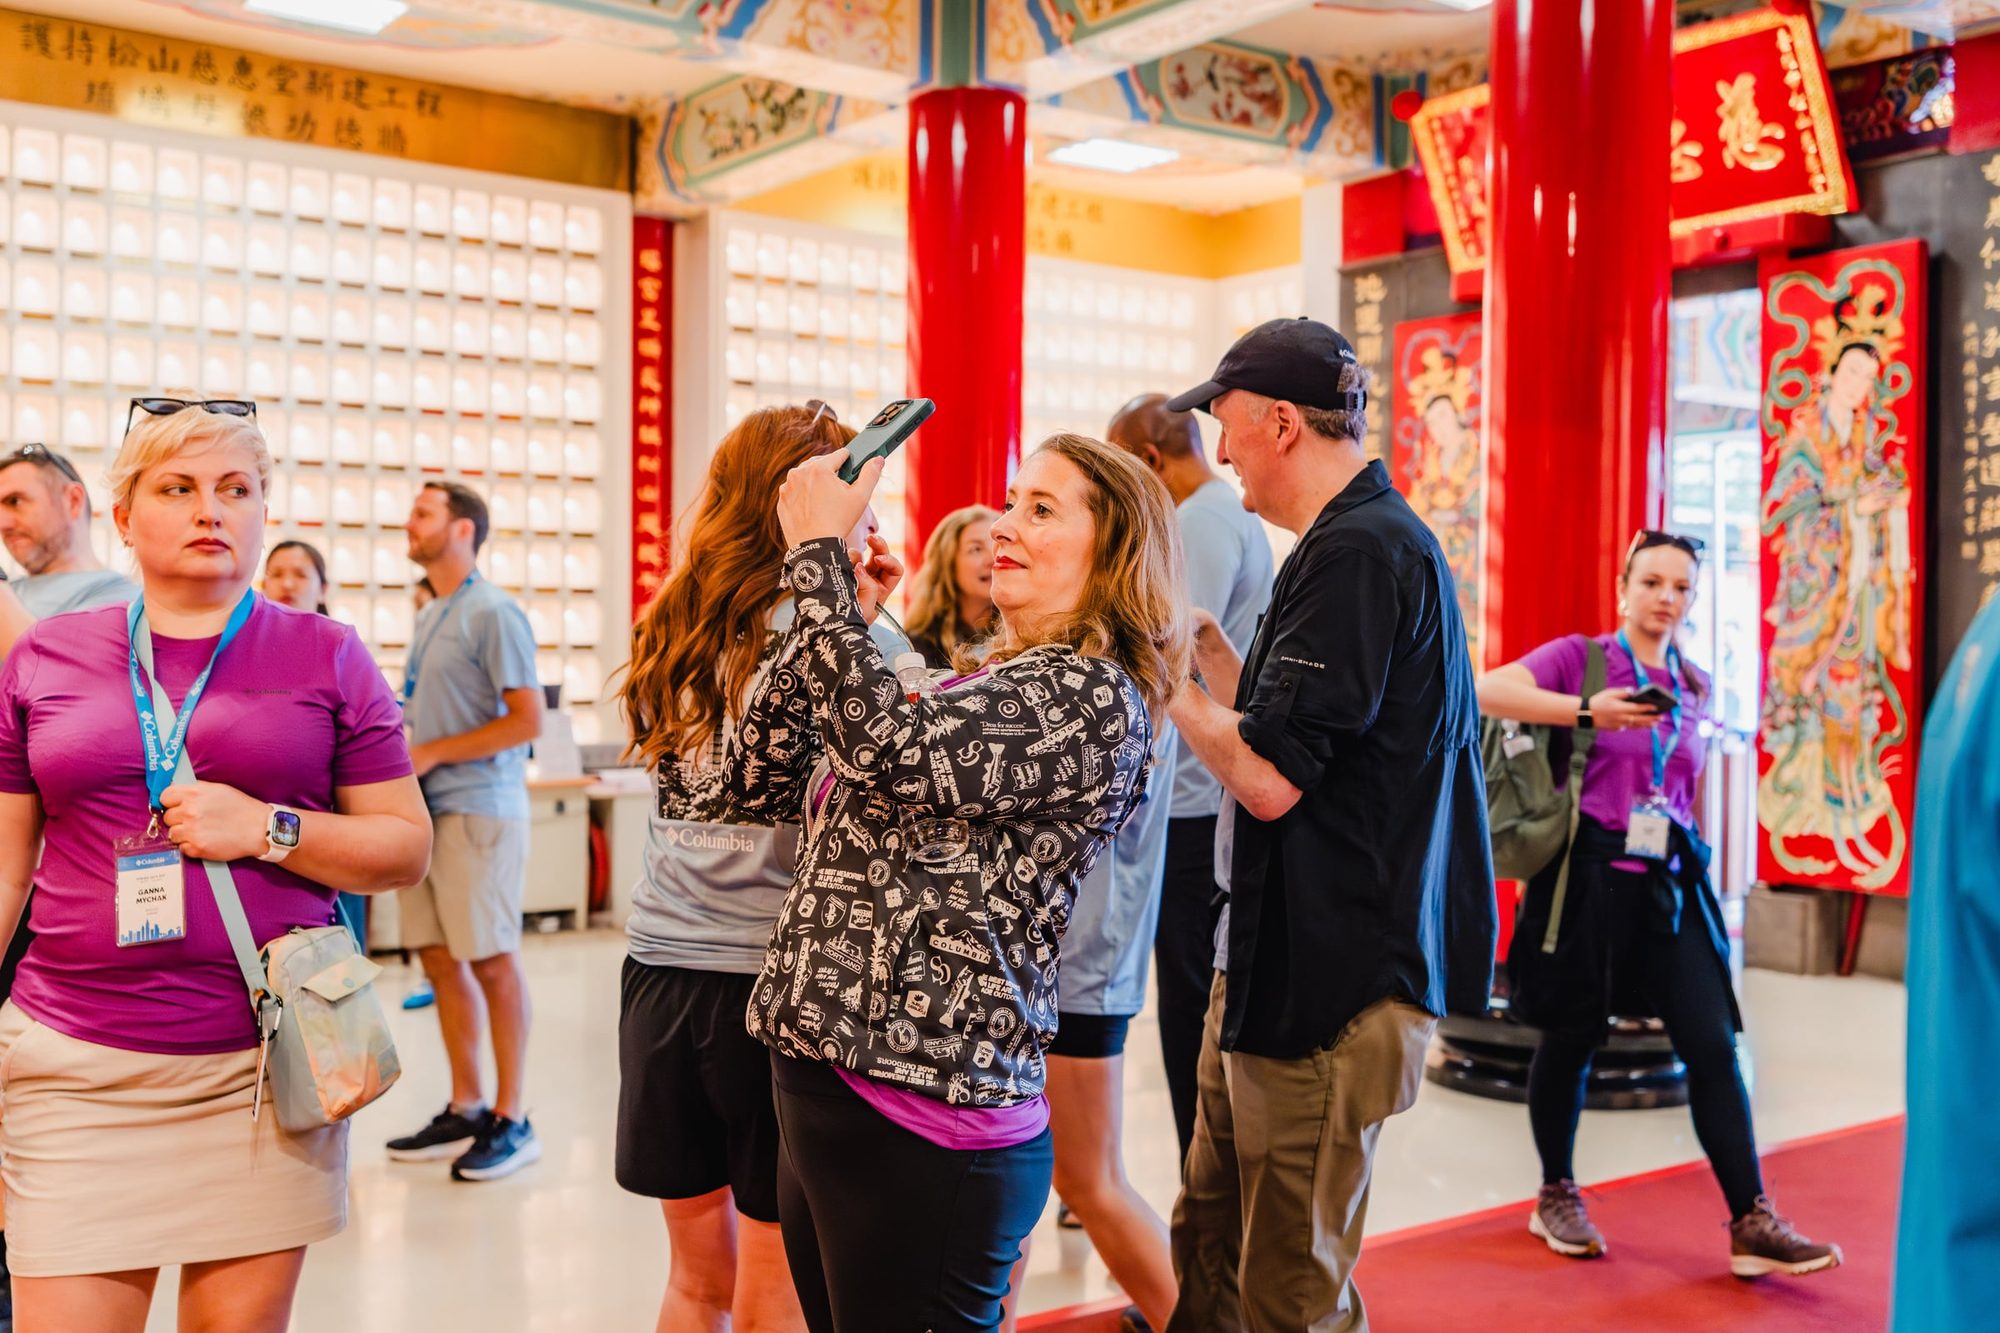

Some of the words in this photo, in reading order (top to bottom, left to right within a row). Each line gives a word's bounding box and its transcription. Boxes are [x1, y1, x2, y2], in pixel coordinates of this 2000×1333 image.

[1280, 655, 1326, 670] OMNI-SHADE
[1033, 701, 1051, 737] Columb
[164, 710, 191, 759] Columbia
[1029, 721, 1081, 751] COLUMBIA
[143, 720, 160, 772] Columbia
[829, 746, 866, 779] OLUMBIA
[926, 750, 938, 770] MADE
[933, 751, 941, 760] IN
[935, 759, 945, 775] LIFE
[941, 756, 952, 775] BEST
[939, 774, 949, 788] ARE
[946, 774, 962, 807] MEMORIES
[1054, 819, 1079, 842] TDOORS
[679, 828, 755, 852] Columbia
[824, 868, 837, 876] BEST
[836, 870, 866, 882] MEMORIES
[833, 876, 844, 884] ARE
[137, 886, 166, 896] GANNA
[814, 880, 828, 889] MADE
[827, 882, 859, 894] OUTDOORS.
[135, 894, 168, 905] MYCHAK
[987, 897, 1018, 915] COLU
[932, 939, 991, 962] COLUMBIA
[824, 945, 862, 973] PORTLAND
[791, 941, 808, 1002] COLUMBIA
[980, 987, 993, 996] ADE
[993, 991, 1022, 1003] OUTDOO
[925, 1036, 960, 1047] PORTLAND
[875, 1056, 917, 1069] OUTDOORS.
[894, 1066, 910, 1075] ARE
[917, 1065, 938, 1074] MADE
[868, 1069, 906, 1082] MEMORIES
[905, 1076, 925, 1085] BEST
[909, 1070, 925, 1078] LIFE
